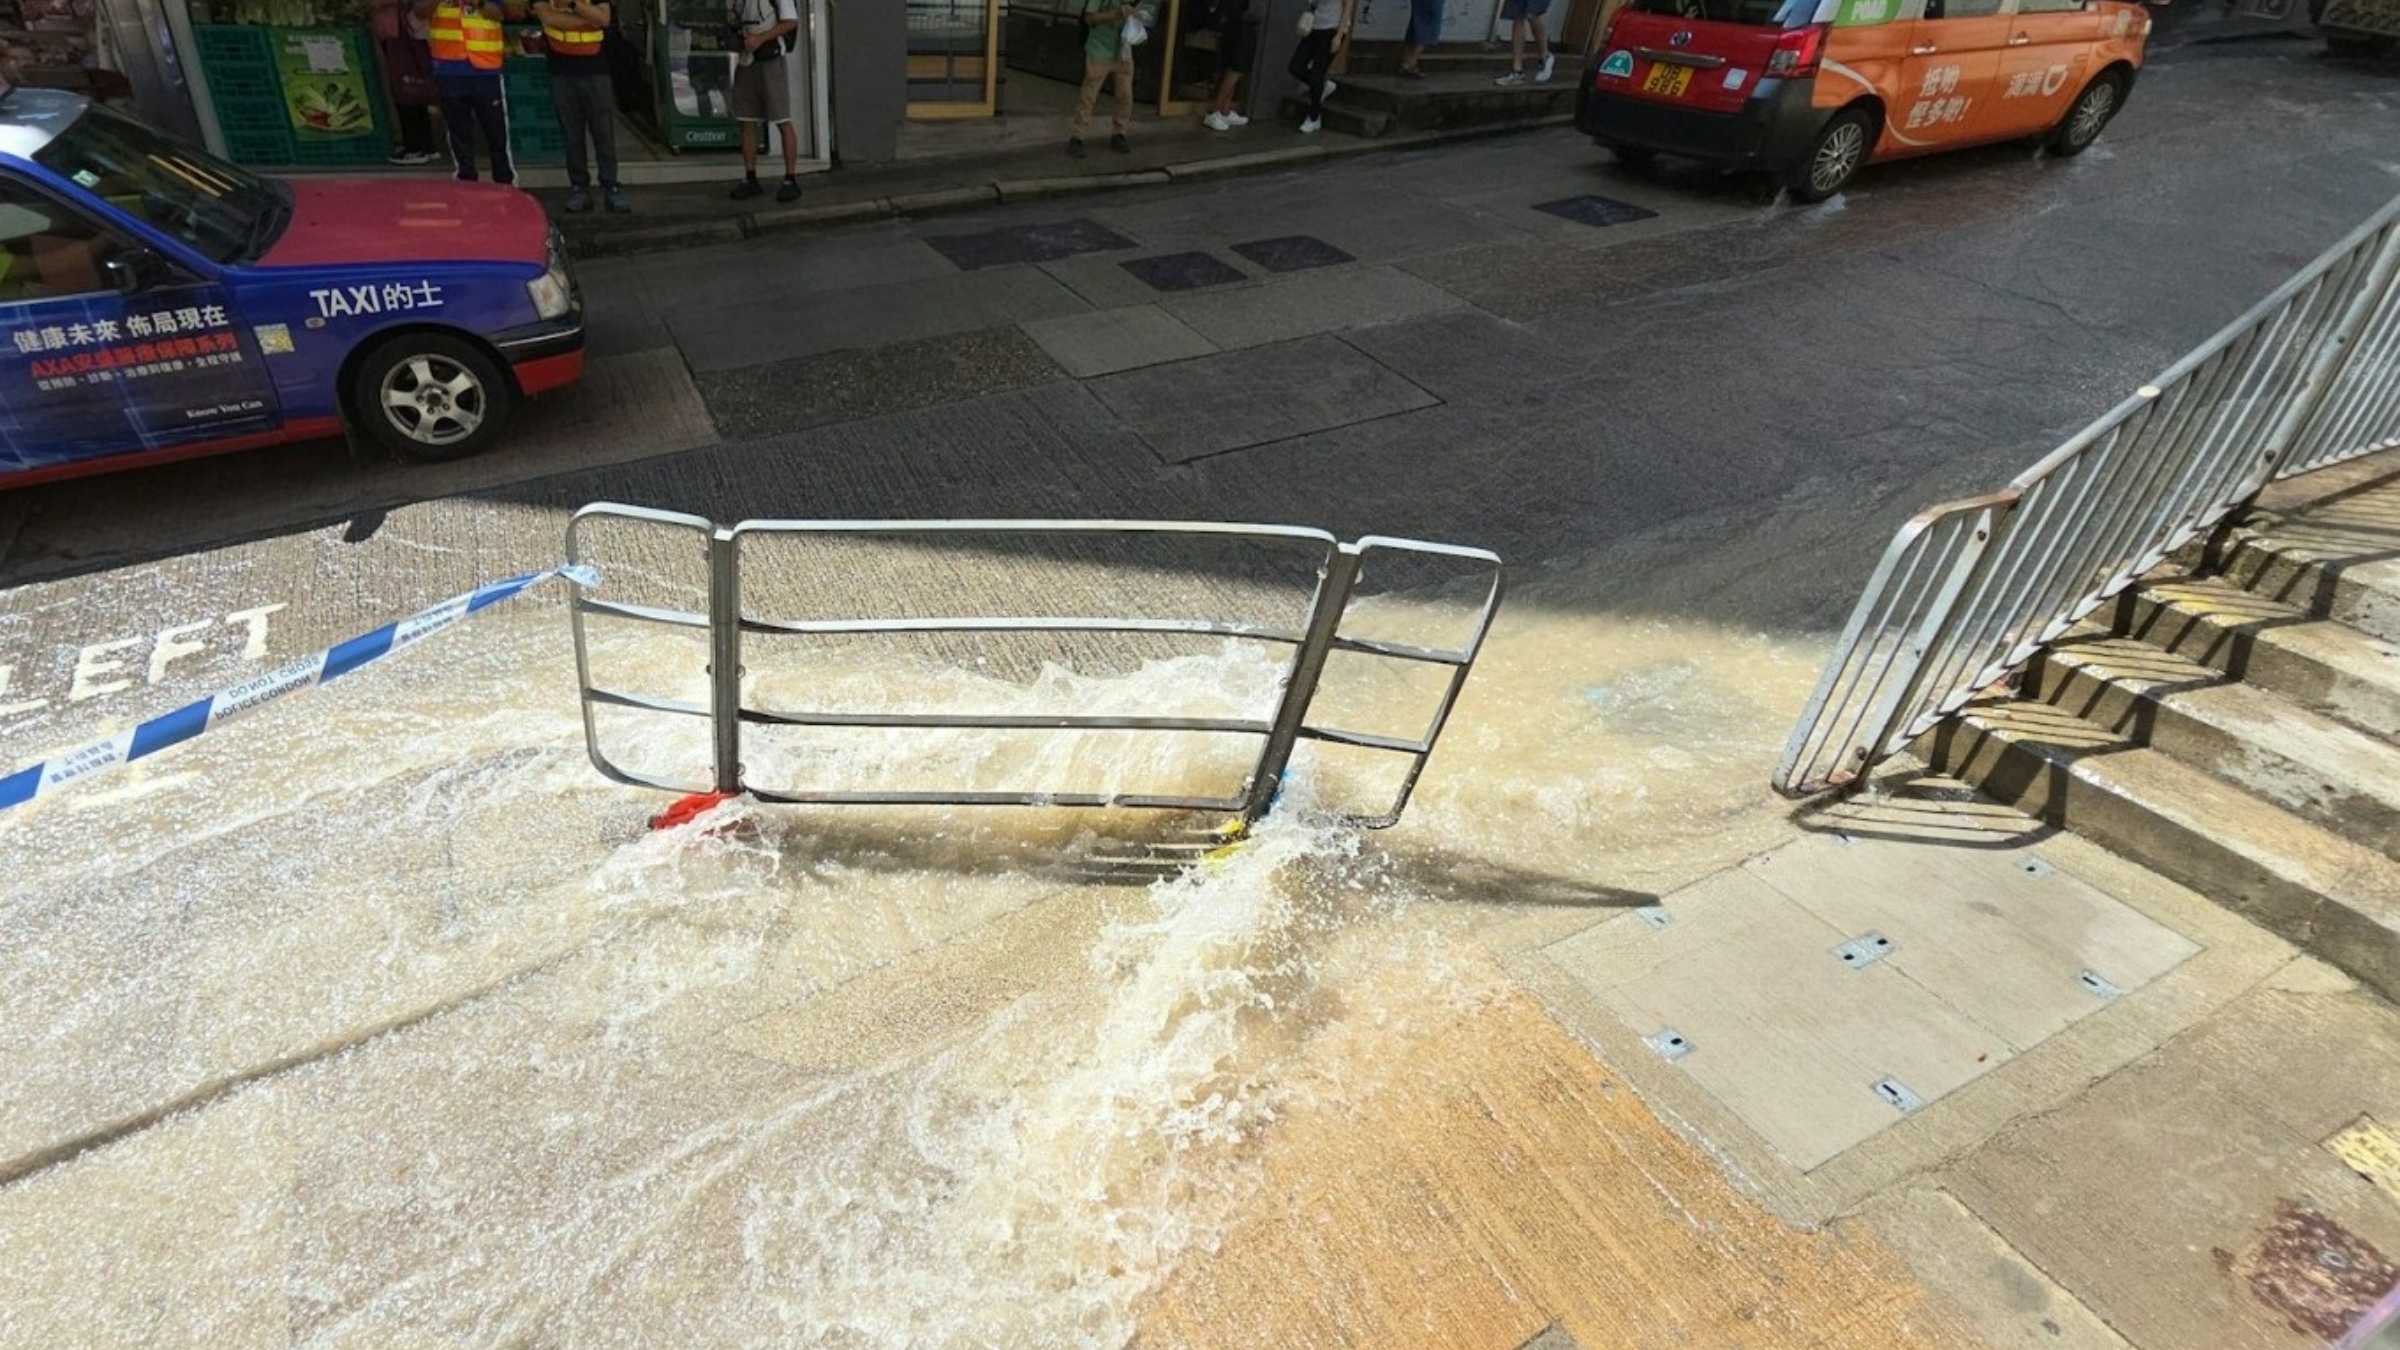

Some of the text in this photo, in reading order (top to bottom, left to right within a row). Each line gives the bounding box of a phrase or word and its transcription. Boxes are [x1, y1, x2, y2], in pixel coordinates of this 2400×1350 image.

[1648, 78, 1681, 95] 986
[309, 279, 444, 317] TAXI 的士
[13, 305, 228, 353] 健康未來 佈局現在
[186, 400, 263, 418] Know You Can
[0, 602, 289, 715] LEFT
